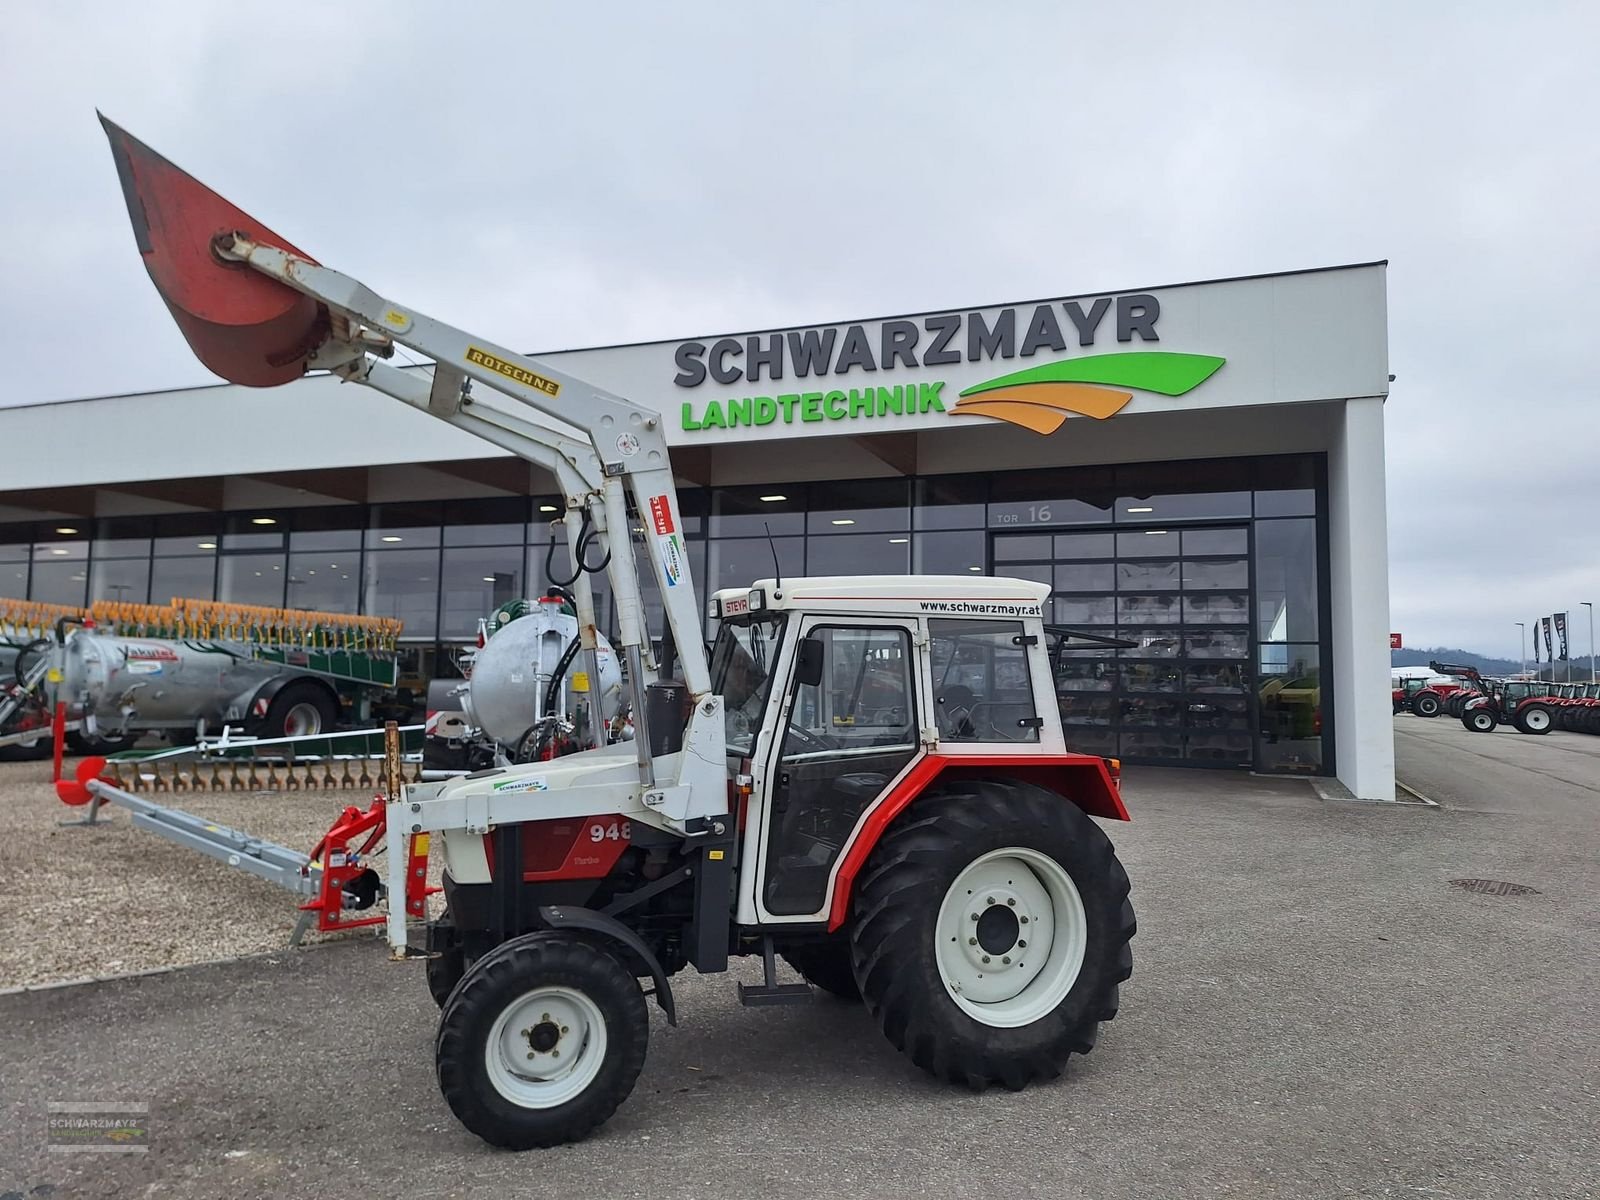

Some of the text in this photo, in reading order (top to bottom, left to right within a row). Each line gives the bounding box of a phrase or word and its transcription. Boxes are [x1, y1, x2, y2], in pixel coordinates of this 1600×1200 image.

[673, 293, 1161, 388] SCHWARZMAYR
[471, 351, 555, 394] ROTSCHNE
[681, 381, 946, 431] LANDTECHNIK
[652, 496, 667, 534] STEYR
[997, 505, 1052, 523] TOR 16
[726, 599, 748, 613] STEYR
[920, 602, 1041, 617] www.schwarzmayr.at
[590, 821, 631, 842] 948
